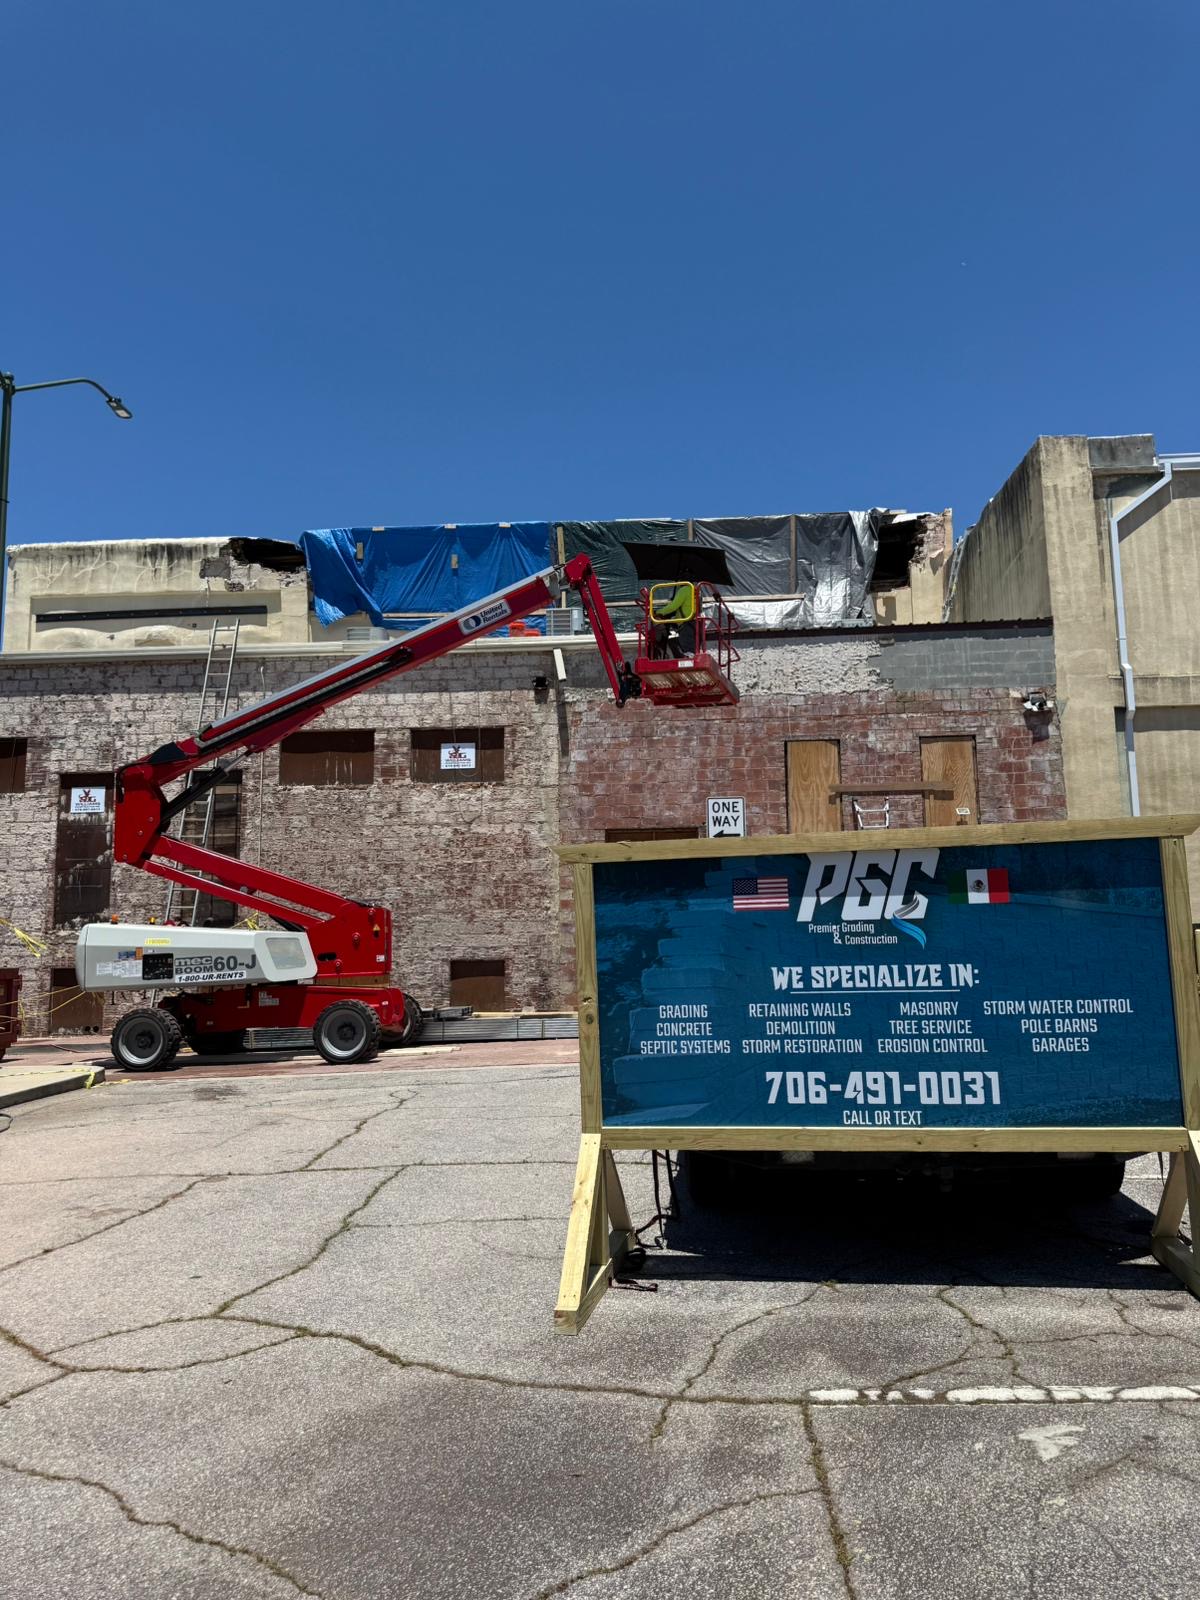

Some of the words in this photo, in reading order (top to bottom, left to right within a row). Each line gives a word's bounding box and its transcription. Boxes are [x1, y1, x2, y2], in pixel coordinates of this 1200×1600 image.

[480, 603, 503, 618] United
[483, 609, 508, 623] Rentals
[712, 801, 740, 813] ONE
[712, 816, 740, 827] WAY
[797, 848, 940, 922] PGC
[808, 923, 841, 933] Premier
[841, 922, 874, 934] Grading
[833, 932, 842, 944] &
[844, 933, 897, 945] Construction
[175, 956, 213, 967] mec
[175, 966, 213, 975] BOOM
[213, 954, 257, 971] 60-J
[178, 972, 244, 982] 1-800-UR-RENTS
[771, 966, 804, 991] WE
[811, 964, 943, 989] SPECIALIZE
[948, 963, 980, 988] IN:
[659, 1004, 708, 1019] GRADING
[749, 1003, 809, 1018] RETAINING
[811, 1002, 851, 1017] WALLS
[899, 1001, 959, 1016] MASONRY
[983, 1000, 1026, 1015] STORM
[1029, 999, 1074, 1015] WATER
[1076, 998, 1134, 1014] CONTROL
[656, 1022, 712, 1037] CONCRETE
[766, 1020, 836, 1035] DEMOLITION
[889, 1020, 919, 1035] TREE
[921, 1019, 973, 1034] SERVICE
[1021, 1018, 1052, 1033] POLE
[1055, 1018, 1098, 1033] BARNS
[640, 1040, 678, 1055] SEPTIC
[680, 1039, 731, 1054] SYSTEMS
[742, 1039, 781, 1054] STORM
[784, 1038, 863, 1053] RESTORATION
[877, 1038, 930, 1053] EROSION
[932, 1038, 988, 1053] CONTROL
[1032, 1037, 1089, 1052] GARAGES
[765, 1071, 1001, 1105] 706-491-0031
[843, 1110, 872, 1125] CALL
[874, 1110, 892, 1125] OR
[893, 1110, 923, 1126] TEXT
